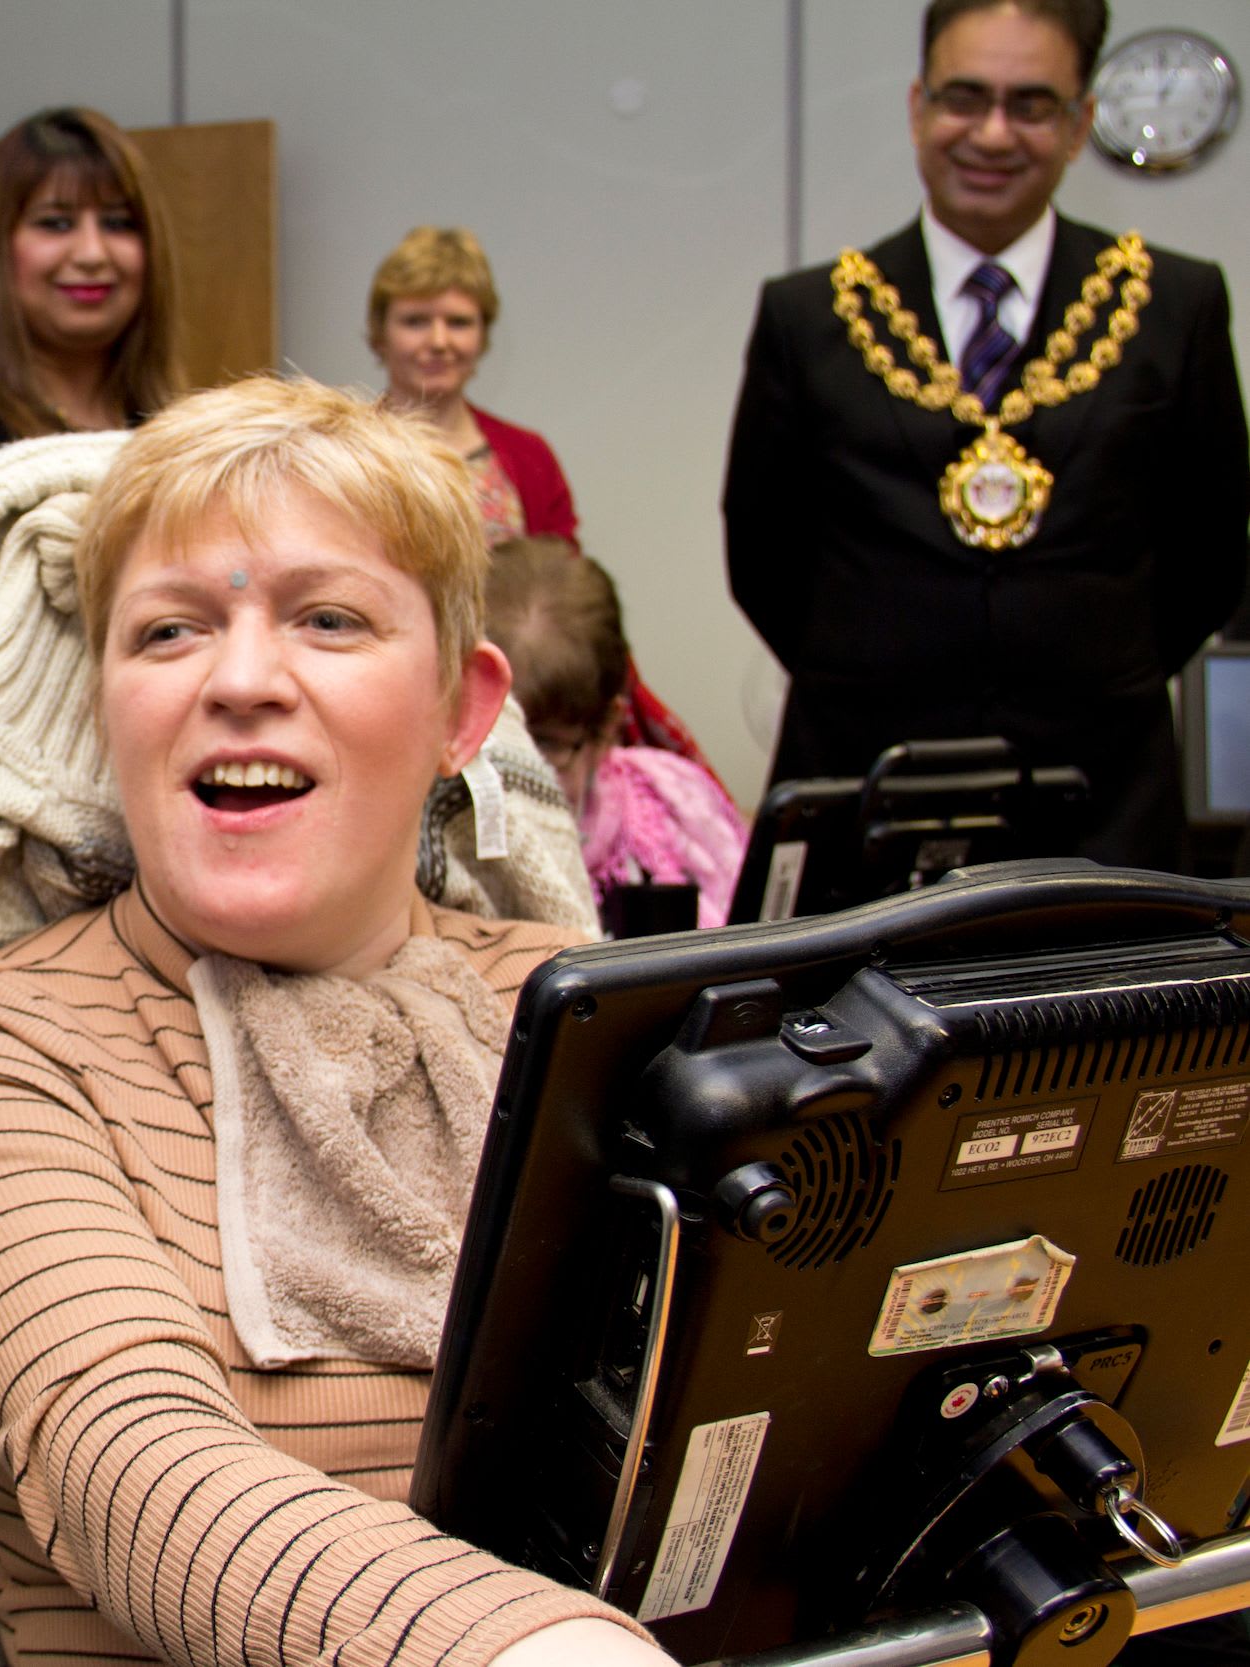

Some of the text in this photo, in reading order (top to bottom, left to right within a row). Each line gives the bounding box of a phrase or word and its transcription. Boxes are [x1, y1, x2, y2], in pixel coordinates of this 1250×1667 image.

[976, 1108, 1075, 1129] PRENTKE ROMICH COMPANY
[1036, 1119, 1060, 1129] SERIAL
[972, 1129, 997, 1139] MODEL
[1032, 1130, 1070, 1144] 972EC2
[968, 1141, 1000, 1154] ECO2
